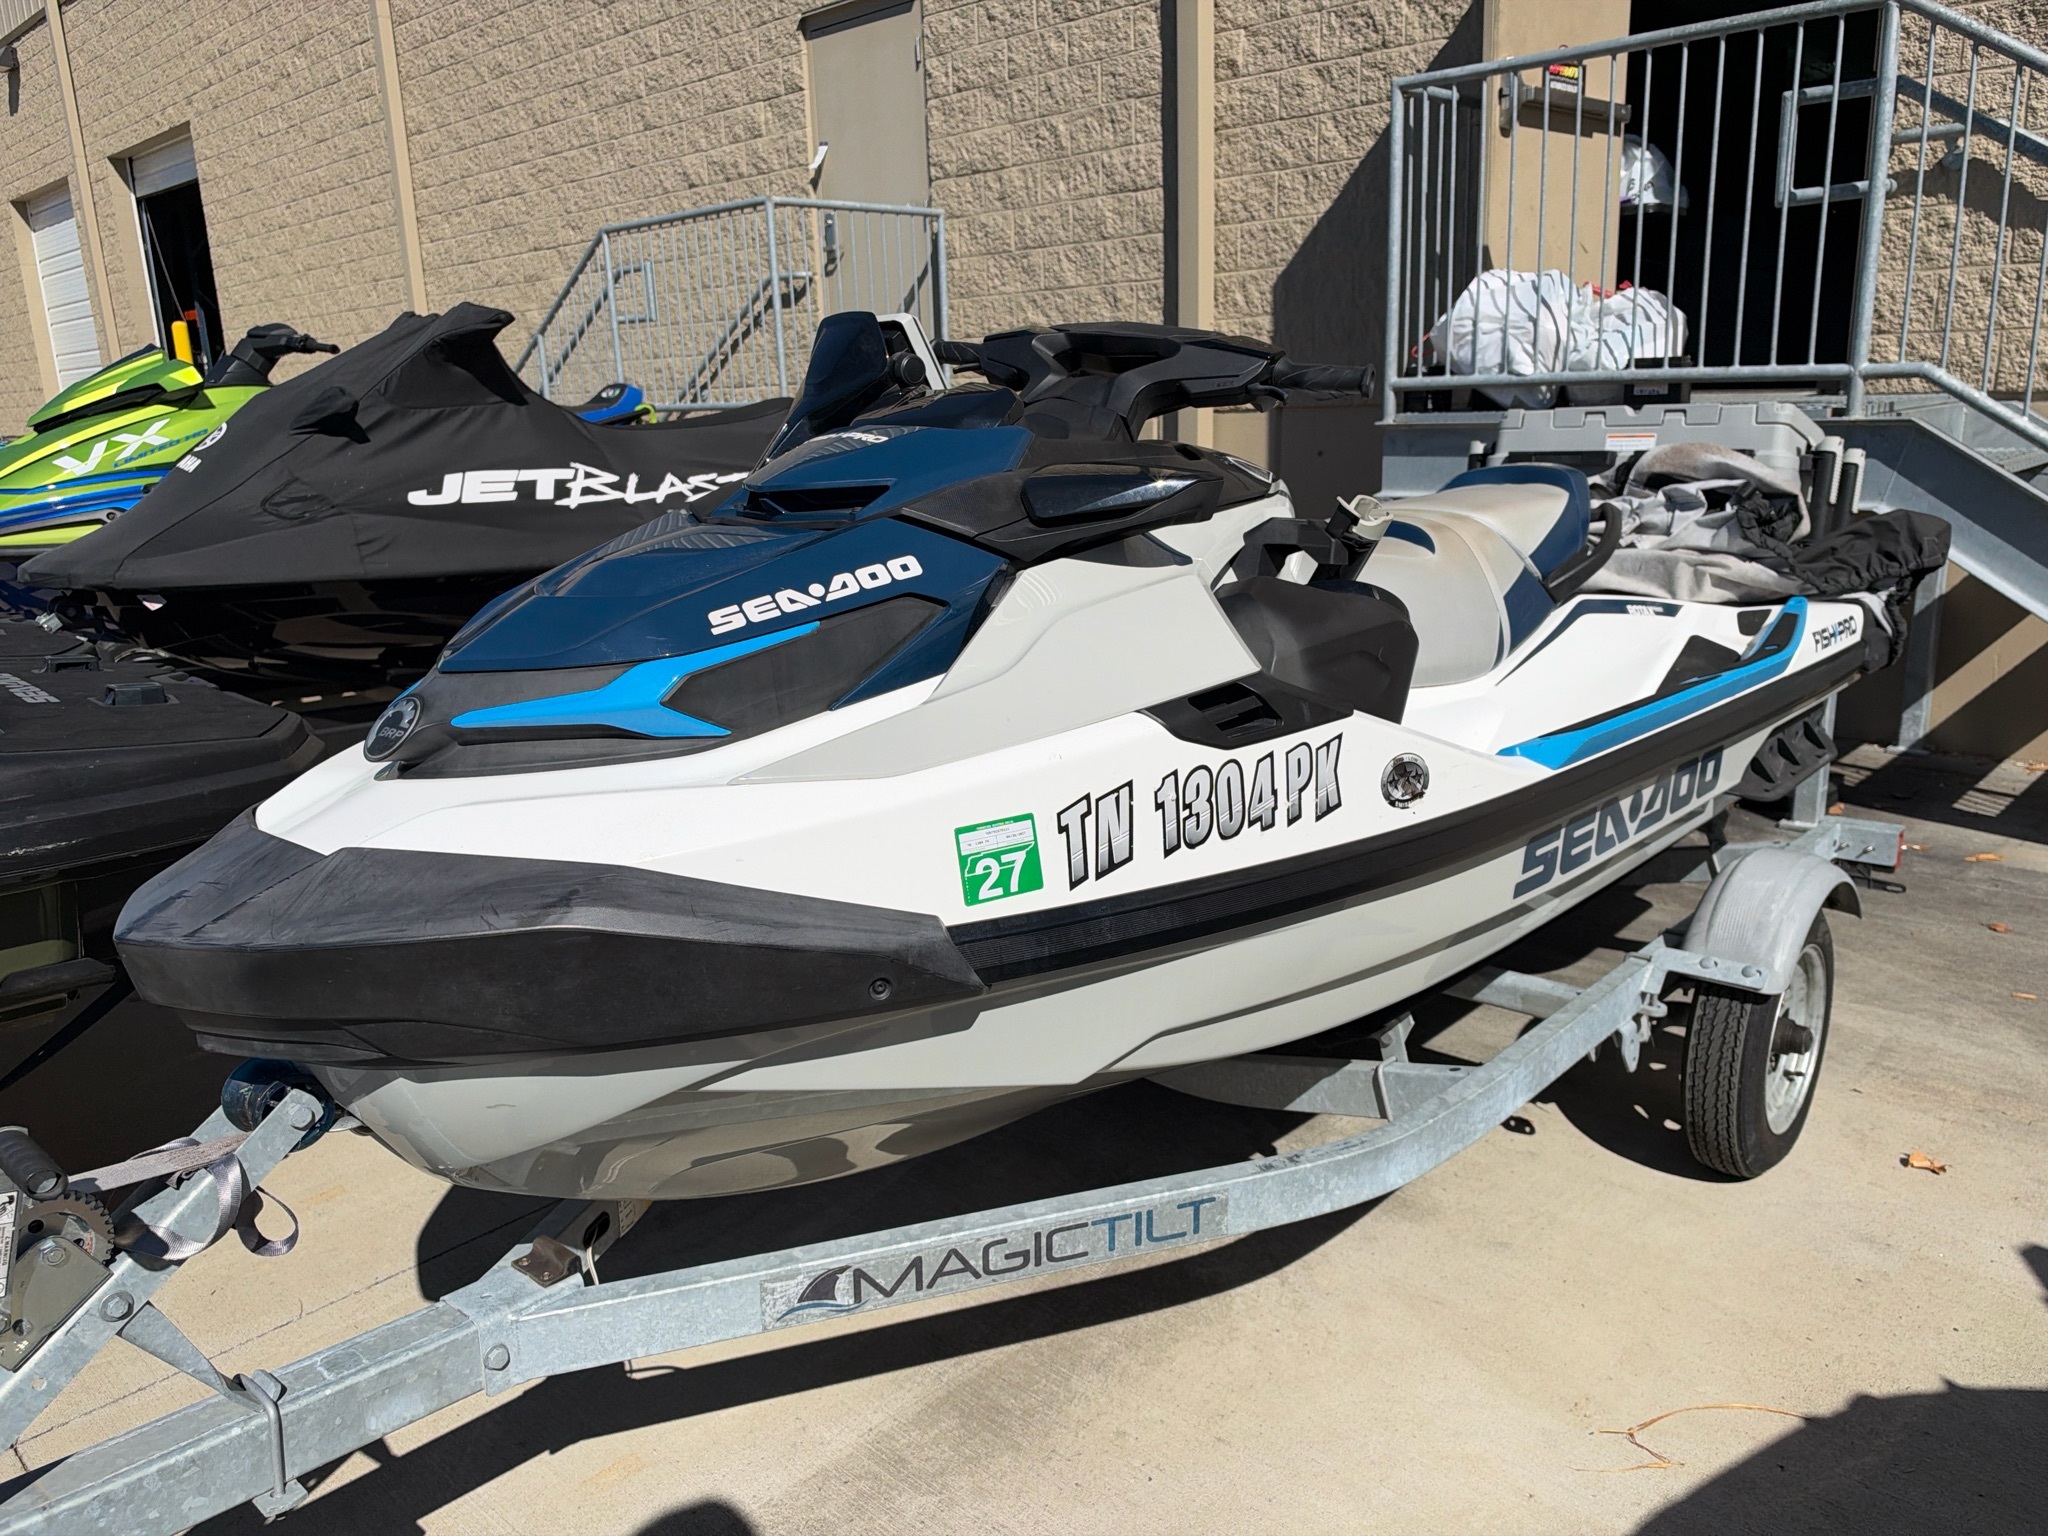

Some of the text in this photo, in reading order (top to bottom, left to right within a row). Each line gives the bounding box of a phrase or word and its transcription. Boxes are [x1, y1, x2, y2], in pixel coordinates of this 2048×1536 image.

[52, 418, 171, 477] VX
[113, 439, 181, 468] LIMITED
[176, 454, 202, 474] AHA
[379, 726, 405, 739] BRP
[1056, 779, 1134, 892] TN
[975, 850, 1027, 901] 27
[854, 1196, 1217, 1304] MAGICTILT
